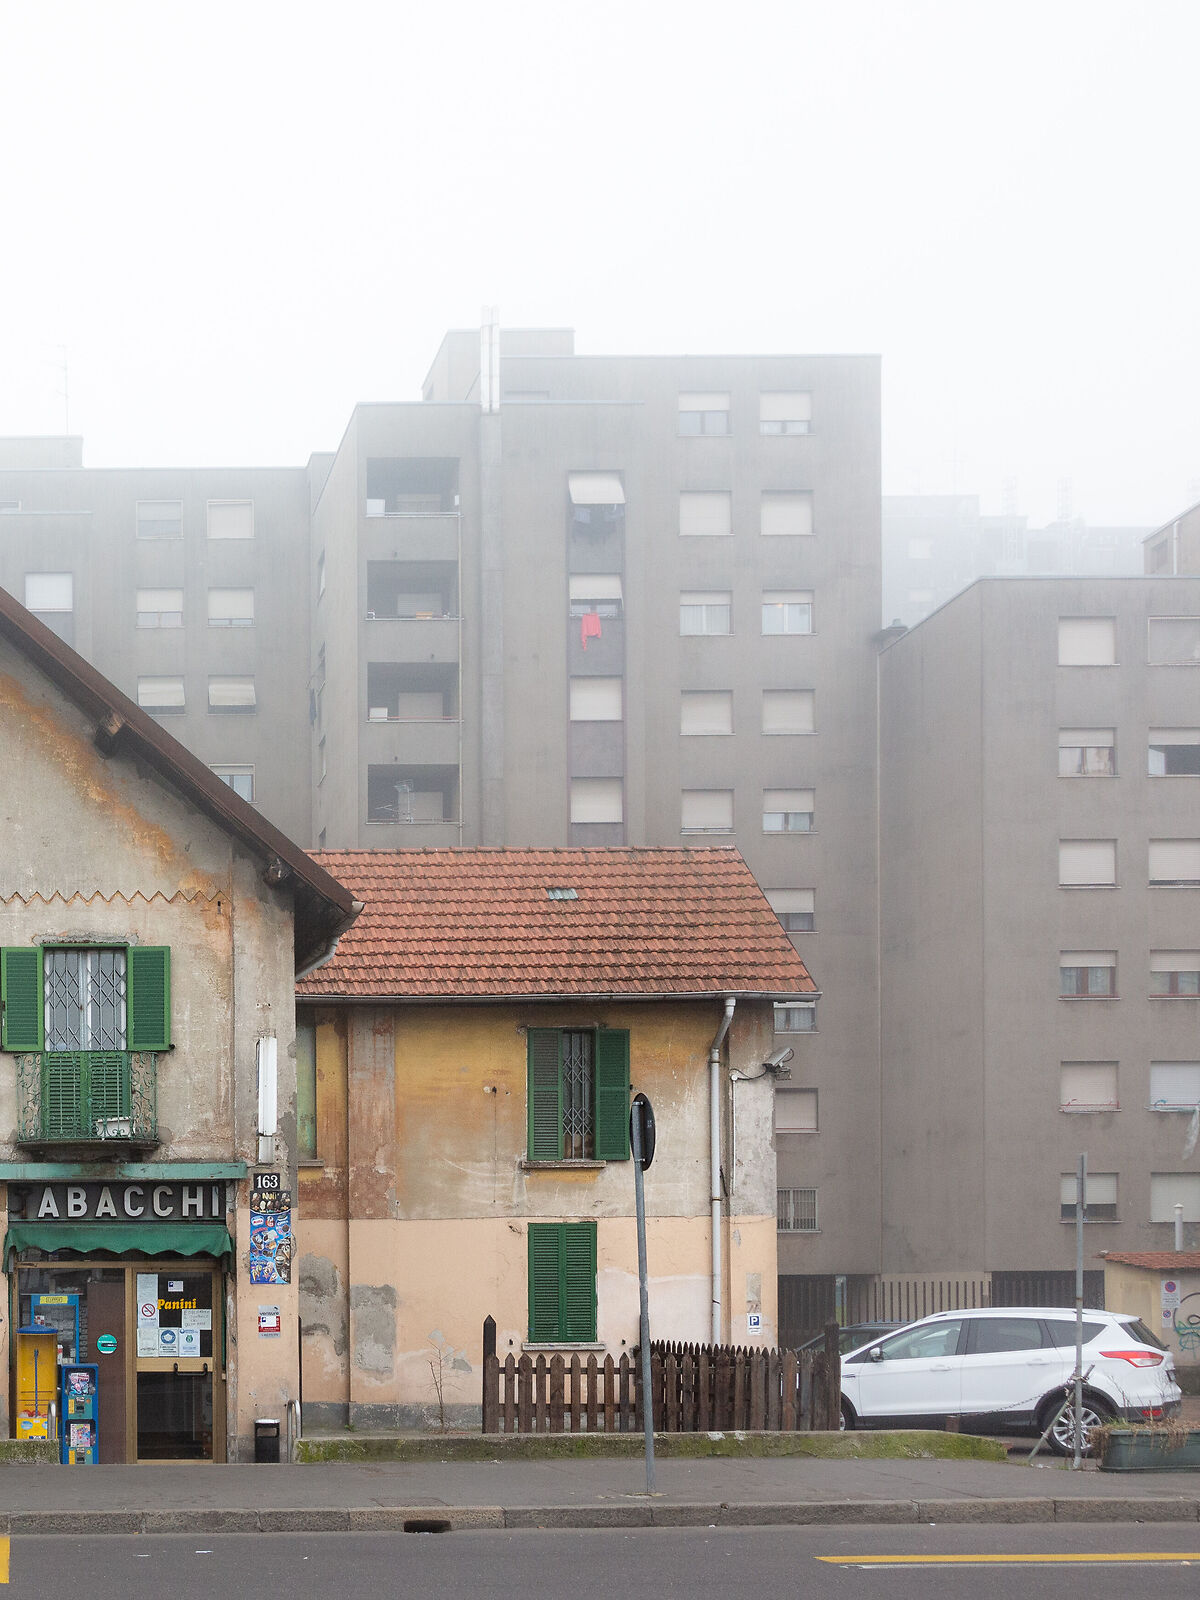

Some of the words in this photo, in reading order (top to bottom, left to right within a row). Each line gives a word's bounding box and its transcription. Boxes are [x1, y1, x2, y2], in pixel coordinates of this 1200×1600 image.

[257, 1175, 278, 1188] 163
[37, 1185, 219, 1218] ABACCHI
[157, 1298, 197, 1310] Panini
